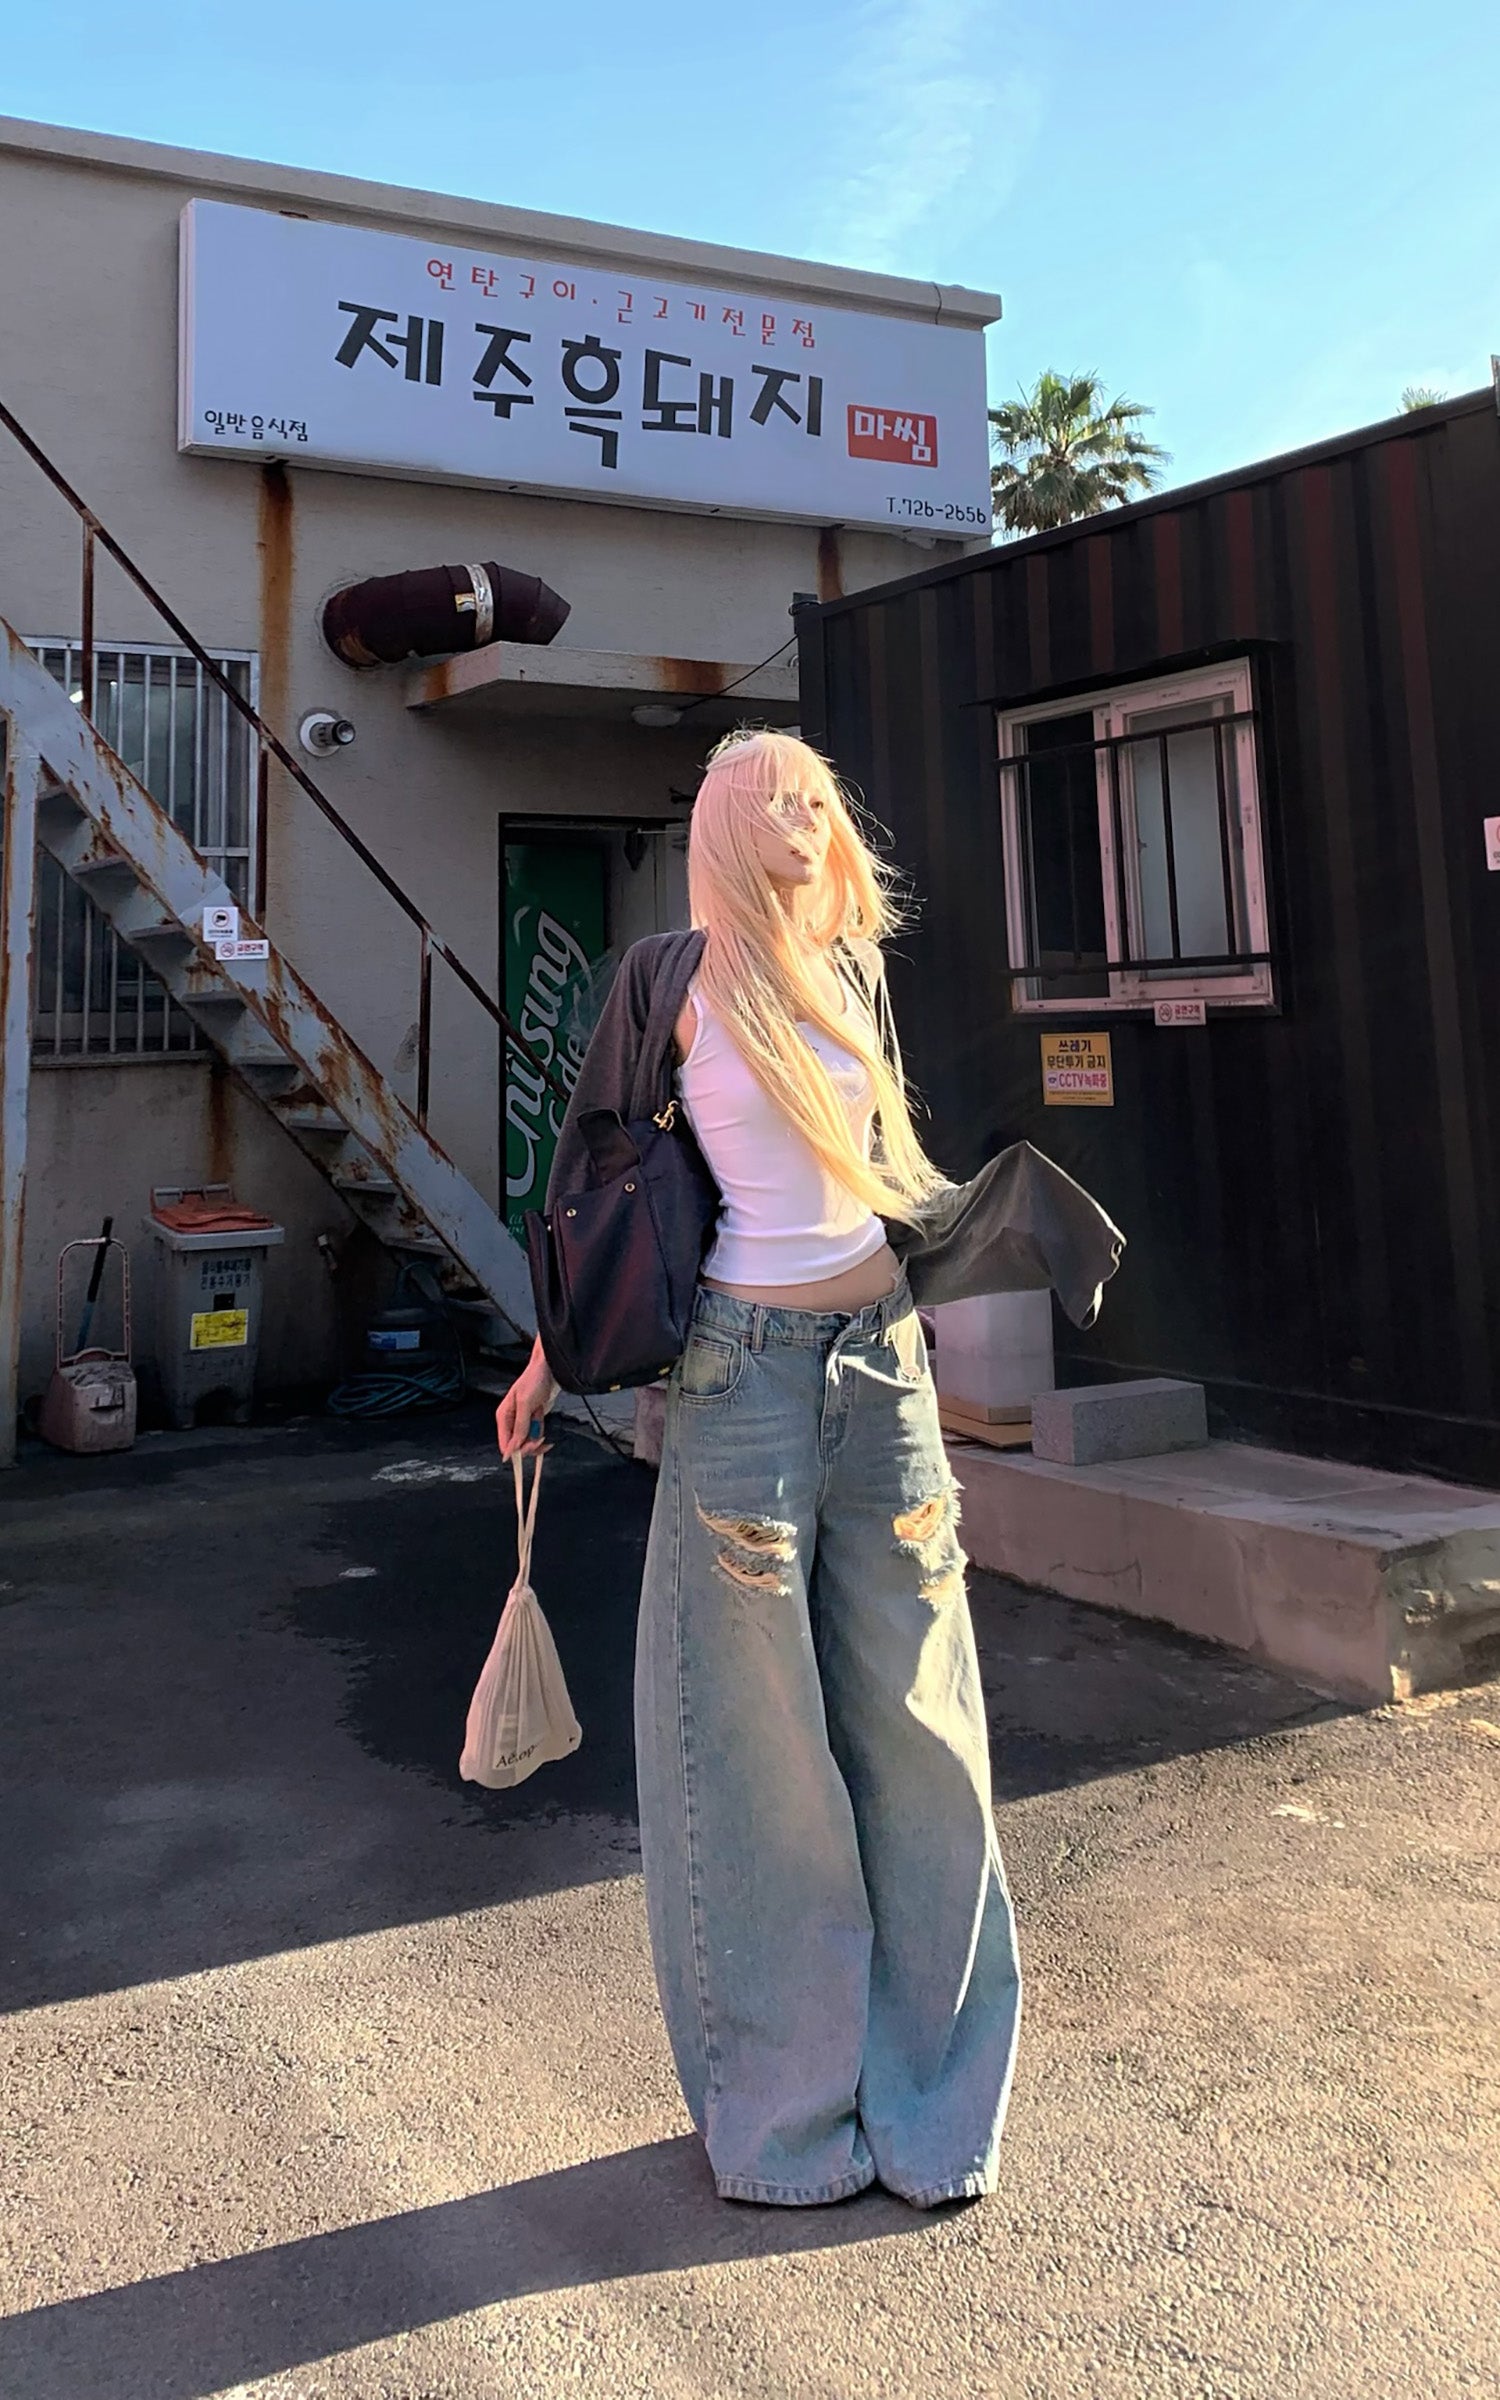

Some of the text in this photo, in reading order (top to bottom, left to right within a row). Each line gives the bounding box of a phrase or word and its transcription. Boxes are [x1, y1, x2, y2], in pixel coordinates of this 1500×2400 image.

[335, 301, 823, 469] 제주흑돼지
[204, 410, 308, 442] 일반음식점
[854, 410, 931, 462] 마씸
[1047, 1055, 1106, 1069] 무단투기 금지
[1059, 1039, 1091, 1053] 쓰레기
